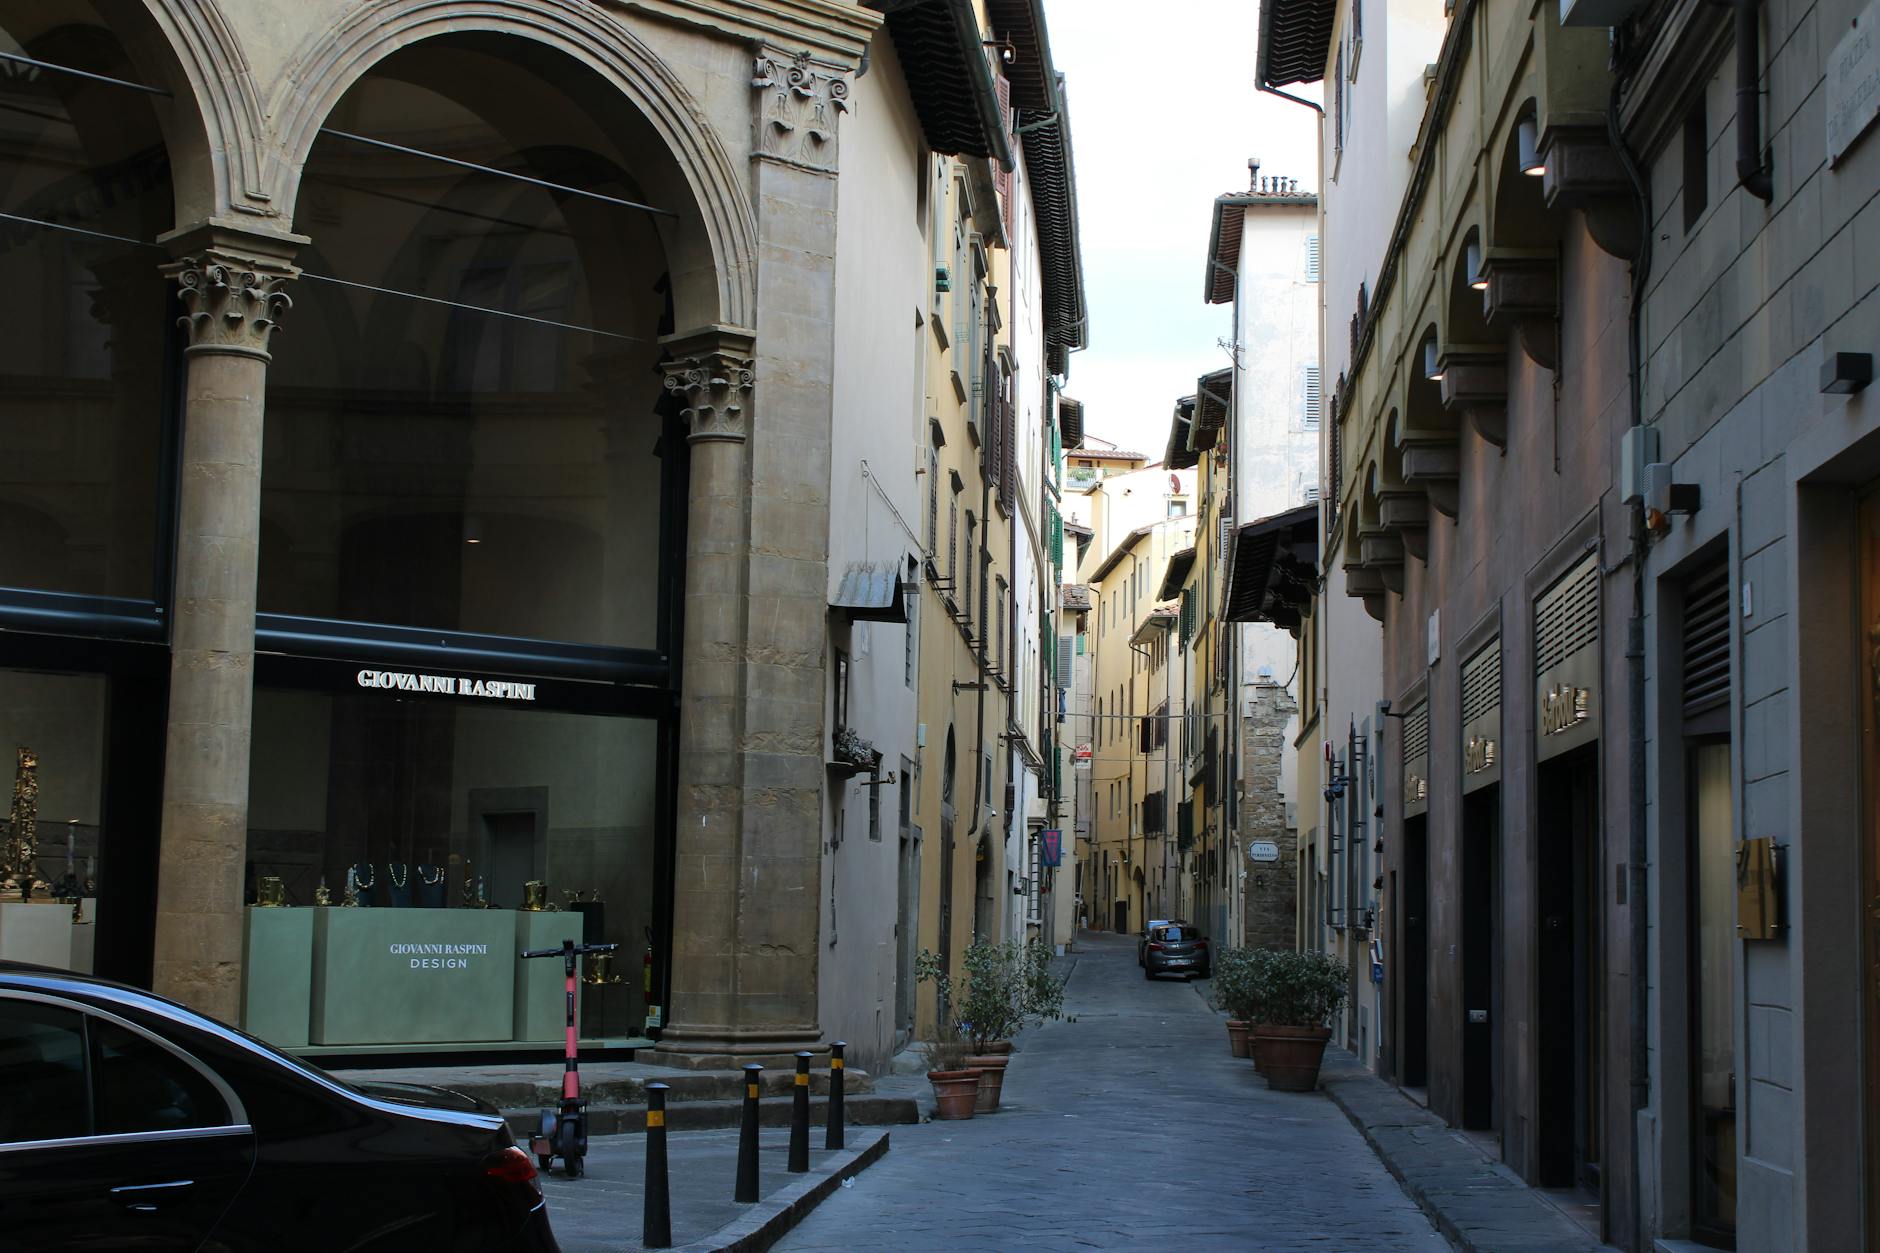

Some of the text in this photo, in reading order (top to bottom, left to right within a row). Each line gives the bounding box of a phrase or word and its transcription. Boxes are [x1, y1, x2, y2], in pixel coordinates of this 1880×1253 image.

[357, 669, 537, 701] GIOVANNI RASPINI
[1542, 683, 1589, 736] Barbour
[390, 943, 488, 954] GIOVANNI RASPINI
[410, 958, 467, 969] DESIGN
